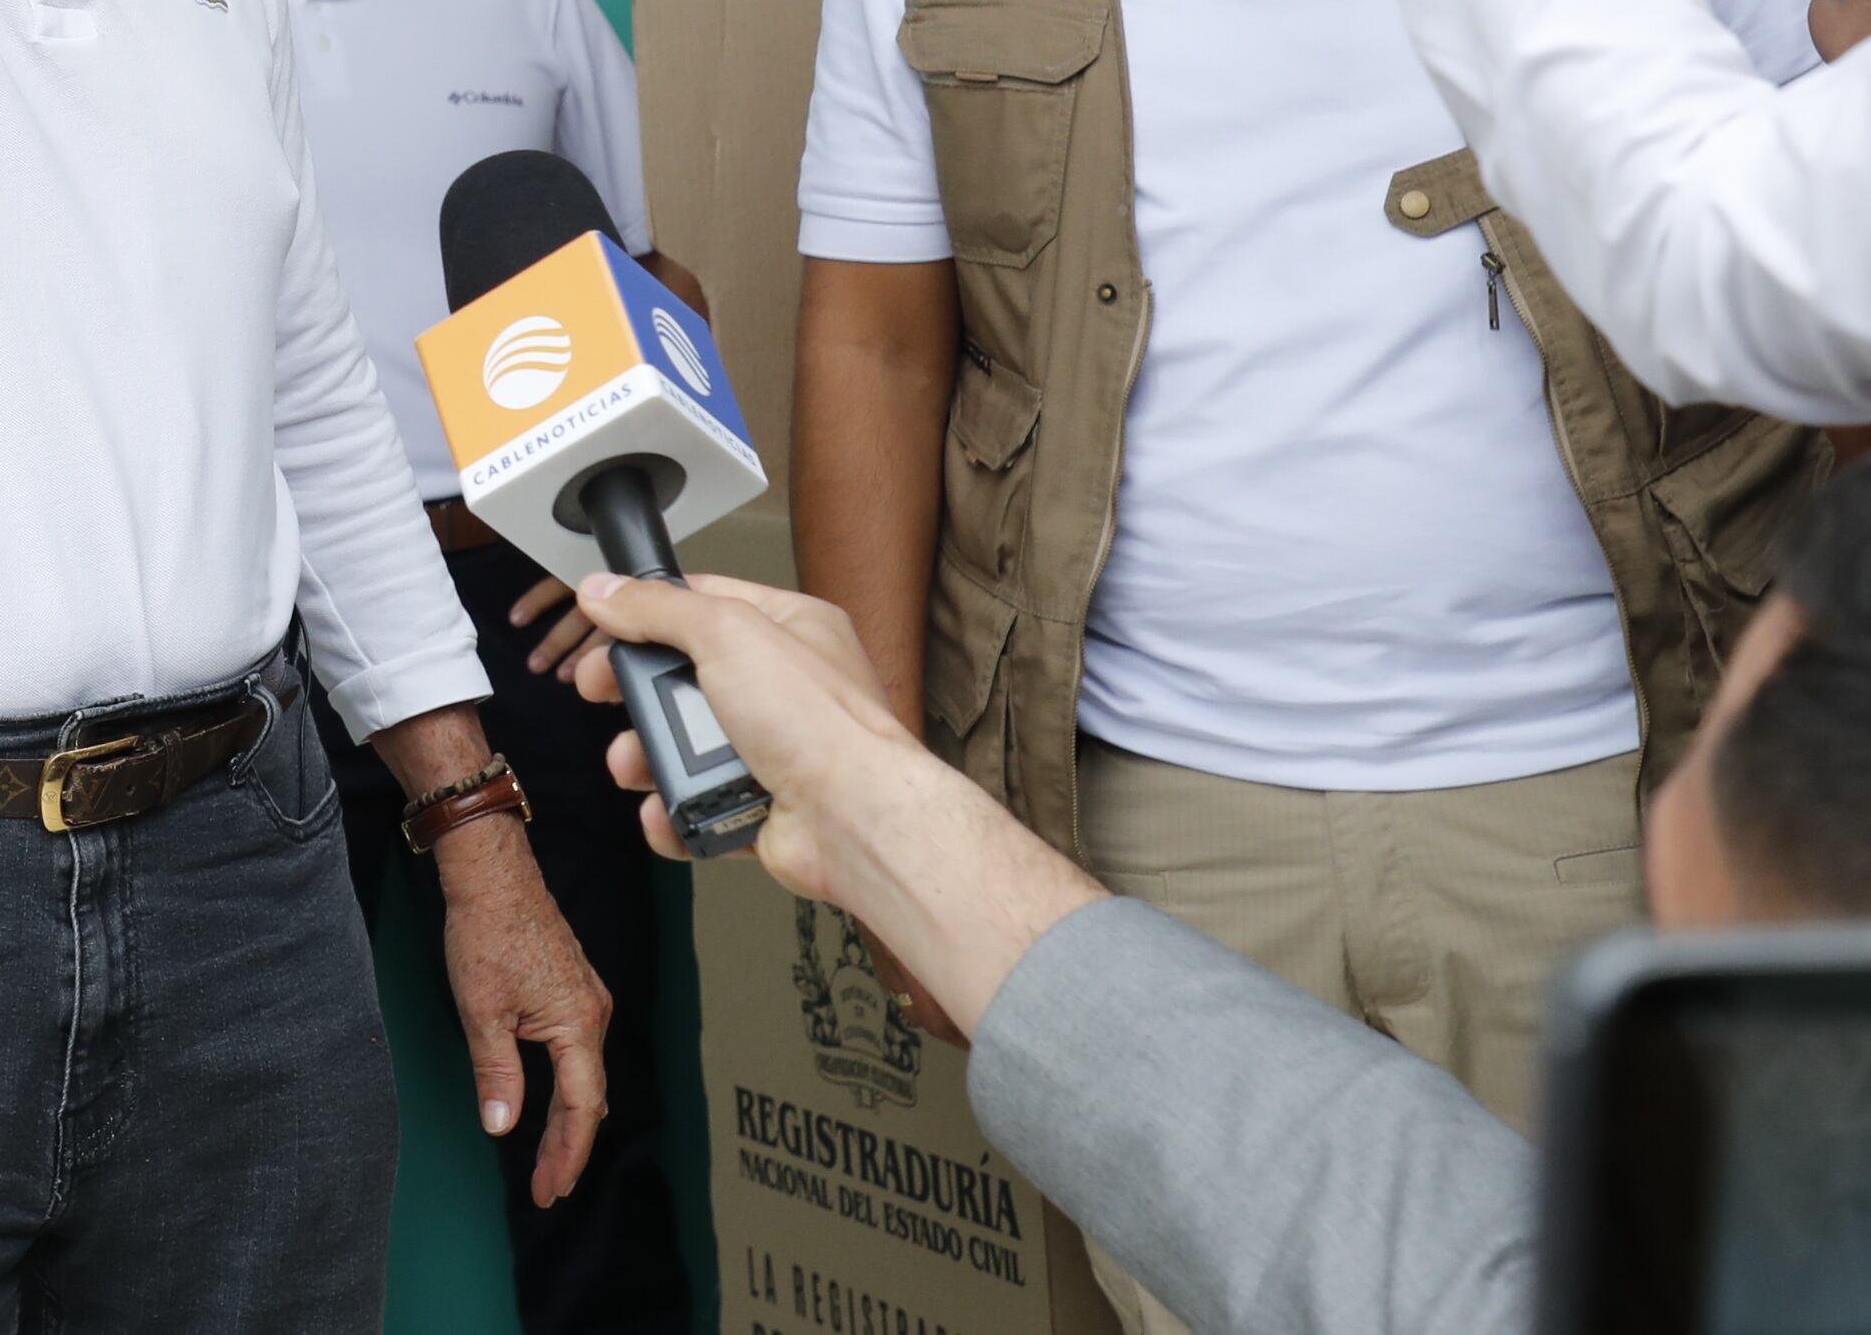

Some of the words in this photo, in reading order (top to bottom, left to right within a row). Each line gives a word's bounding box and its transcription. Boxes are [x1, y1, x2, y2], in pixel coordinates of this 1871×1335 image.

[473, 384, 633, 486] CABLENOTICIAS
[734, 1084, 1022, 1242] REGISTRADURÍA
[738, 1147, 834, 1211] NACIONAL
[838, 1183, 879, 1229] DEL
[882, 1201, 963, 1262] ESTADO
[968, 1236, 1026, 1288] CIVIL
[746, 1245, 778, 1305] LA
